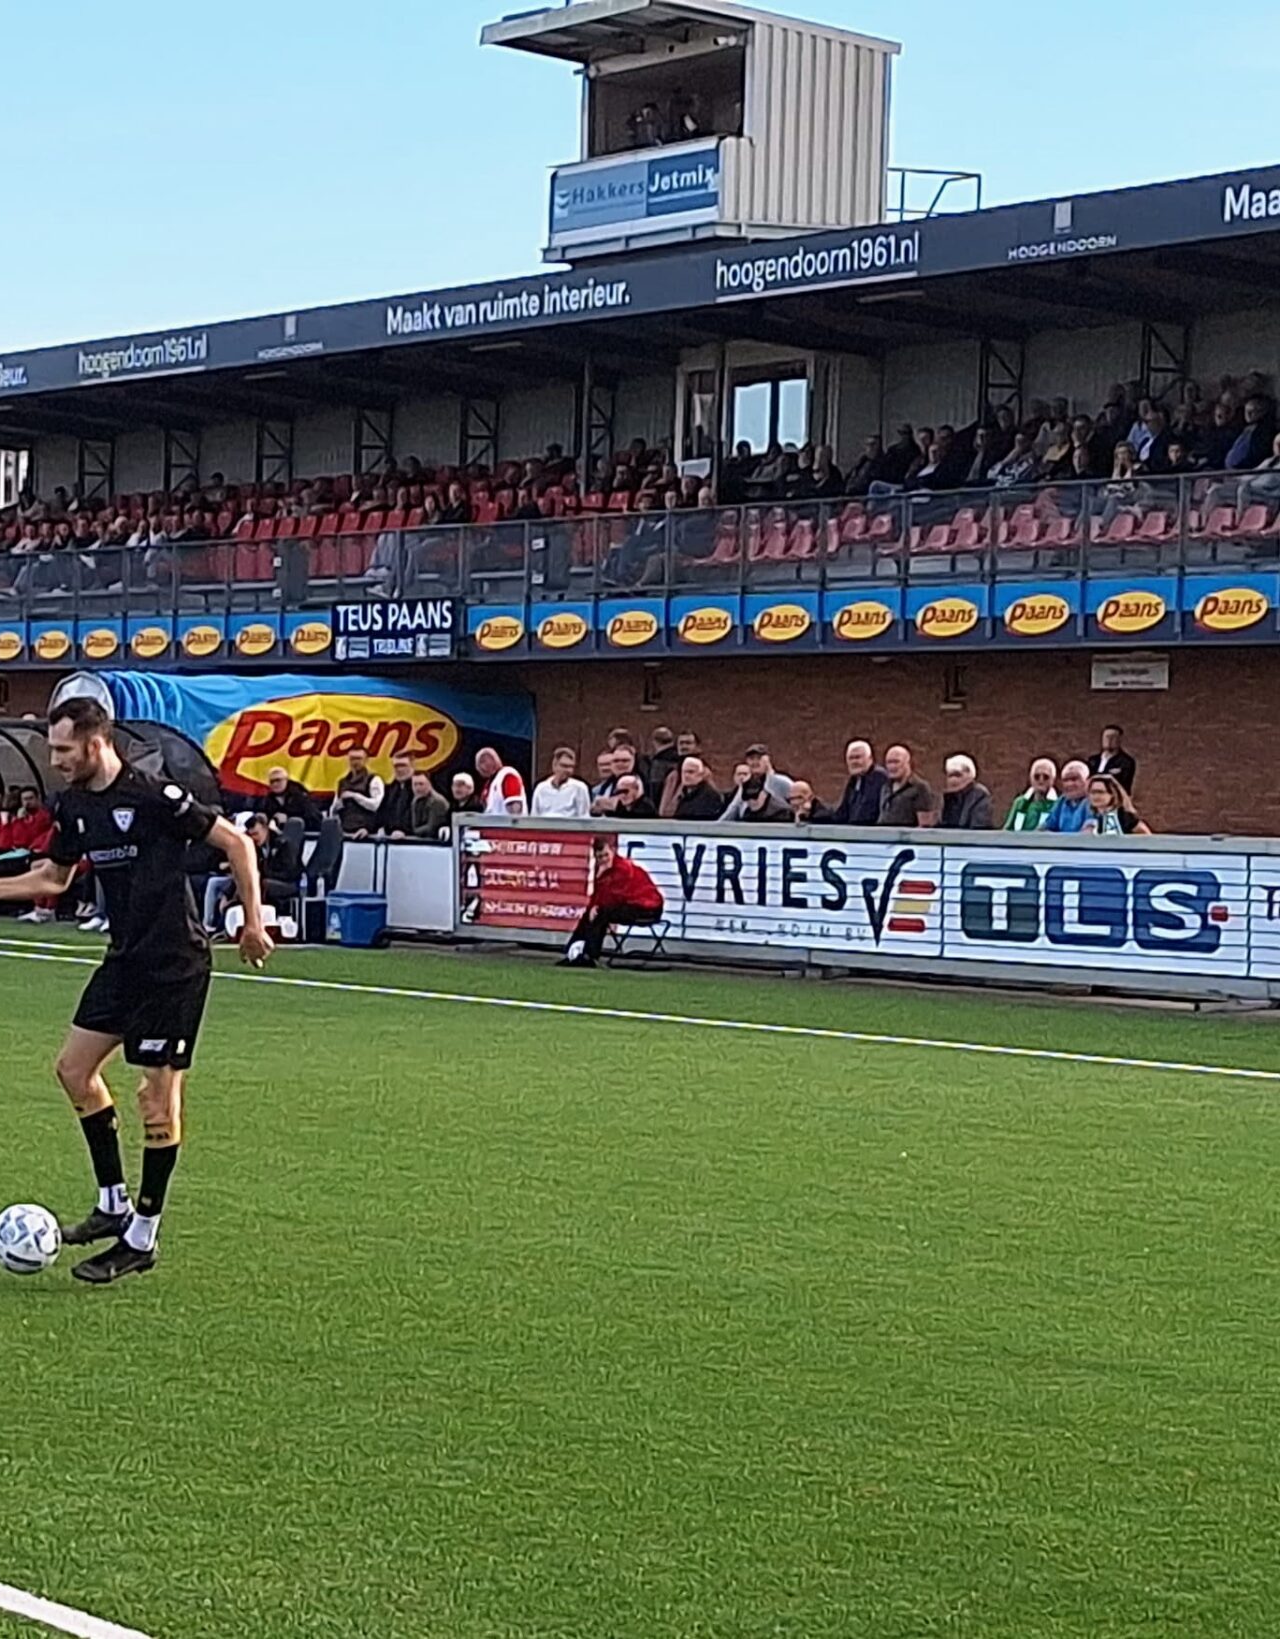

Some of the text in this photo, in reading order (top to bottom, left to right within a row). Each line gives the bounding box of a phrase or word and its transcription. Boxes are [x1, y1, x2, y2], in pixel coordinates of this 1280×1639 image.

[571, 180, 645, 204] Hakkers
[649, 164, 715, 193] Jetmix
[716, 231, 919, 292] hoogendoorn1961.nl
[387, 278, 630, 335] Maakt van ruimte interieur.
[336, 600, 452, 632] TEUS PAANS
[922, 606, 975, 631] Paans
[1012, 602, 1065, 626] Paans
[1097, 600, 1162, 624] Paans
[1198, 596, 1263, 622] Paans
[222, 710, 446, 790] Paans
[672, 842, 848, 911] VRIES
[973, 876, 1203, 941] TLS
